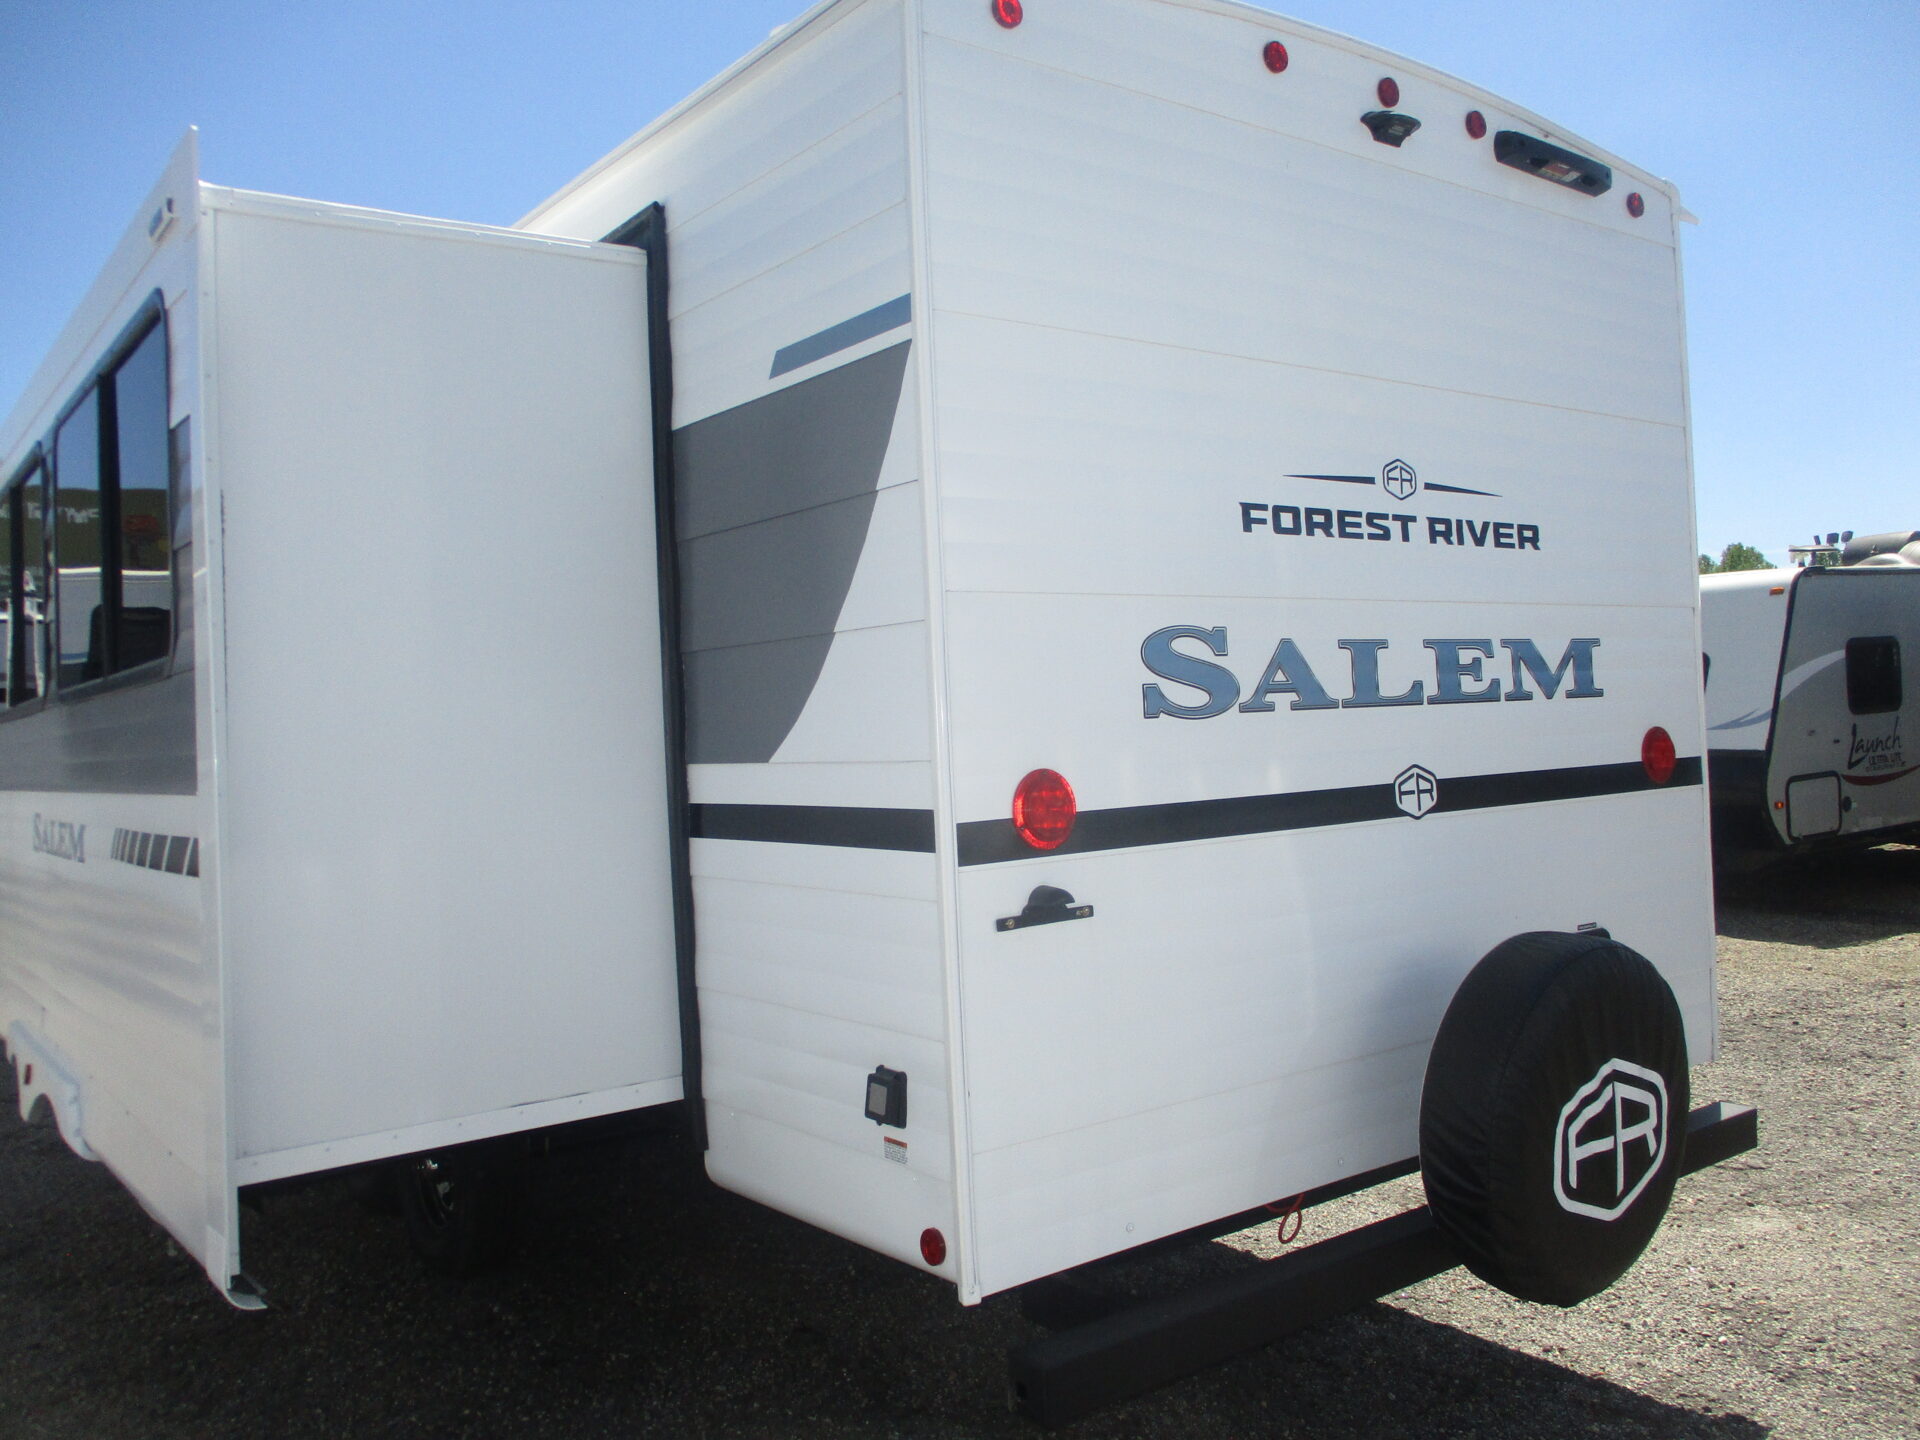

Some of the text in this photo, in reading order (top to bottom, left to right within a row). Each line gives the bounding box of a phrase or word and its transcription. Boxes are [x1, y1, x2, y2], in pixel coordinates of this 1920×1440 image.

[1239, 502, 1541, 551] FOREST RIVER
[1140, 624, 1604, 720] SALEM
[1848, 716, 1903, 769] Launch
[33, 812, 86, 864] SALEM
